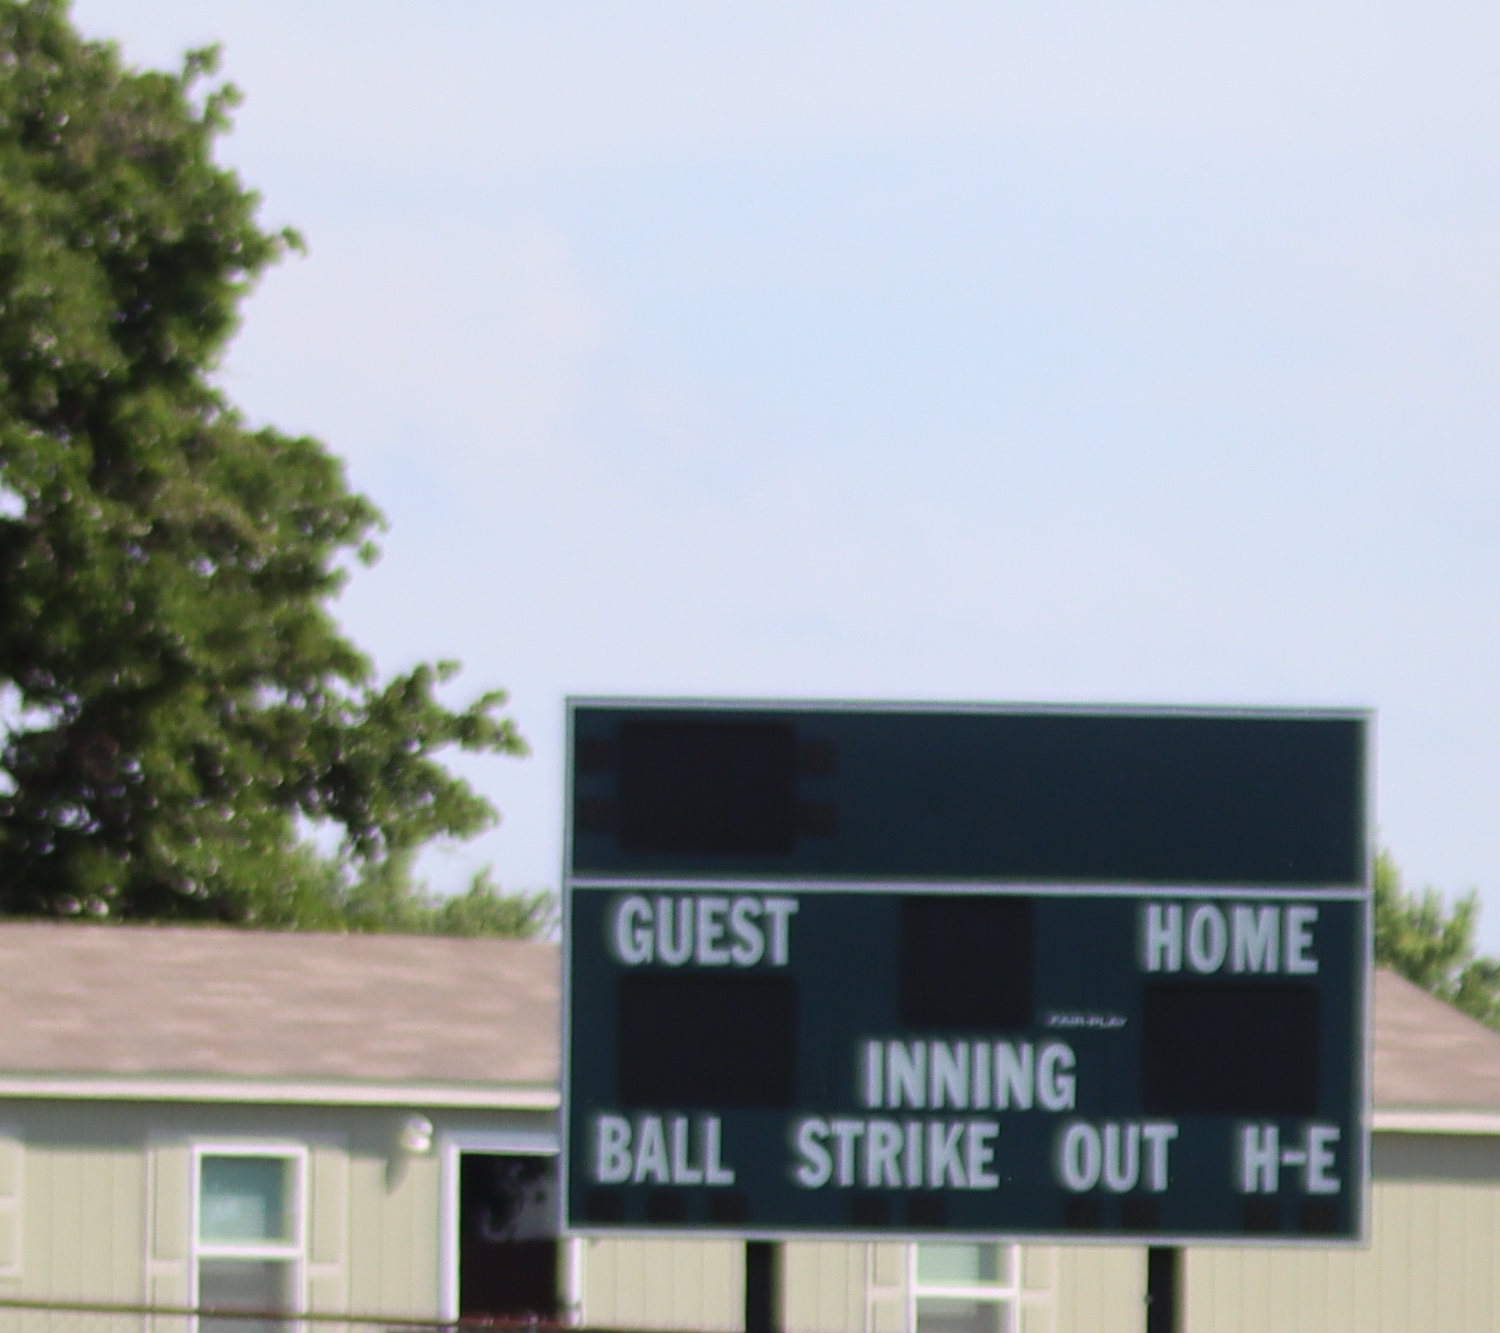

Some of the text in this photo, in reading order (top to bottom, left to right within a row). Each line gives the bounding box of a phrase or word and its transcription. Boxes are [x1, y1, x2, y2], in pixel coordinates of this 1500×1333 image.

[611, 894, 800, 967] GUEST
[1143, 902, 1319, 975] HOME
[861, 1039, 1077, 1112] INNING
[592, 1113, 736, 1186] BALL
[793, 1116, 1000, 1190] STRIKE
[1057, 1121, 1179, 1193] OUT
[1238, 1123, 1341, 1194] H-E
